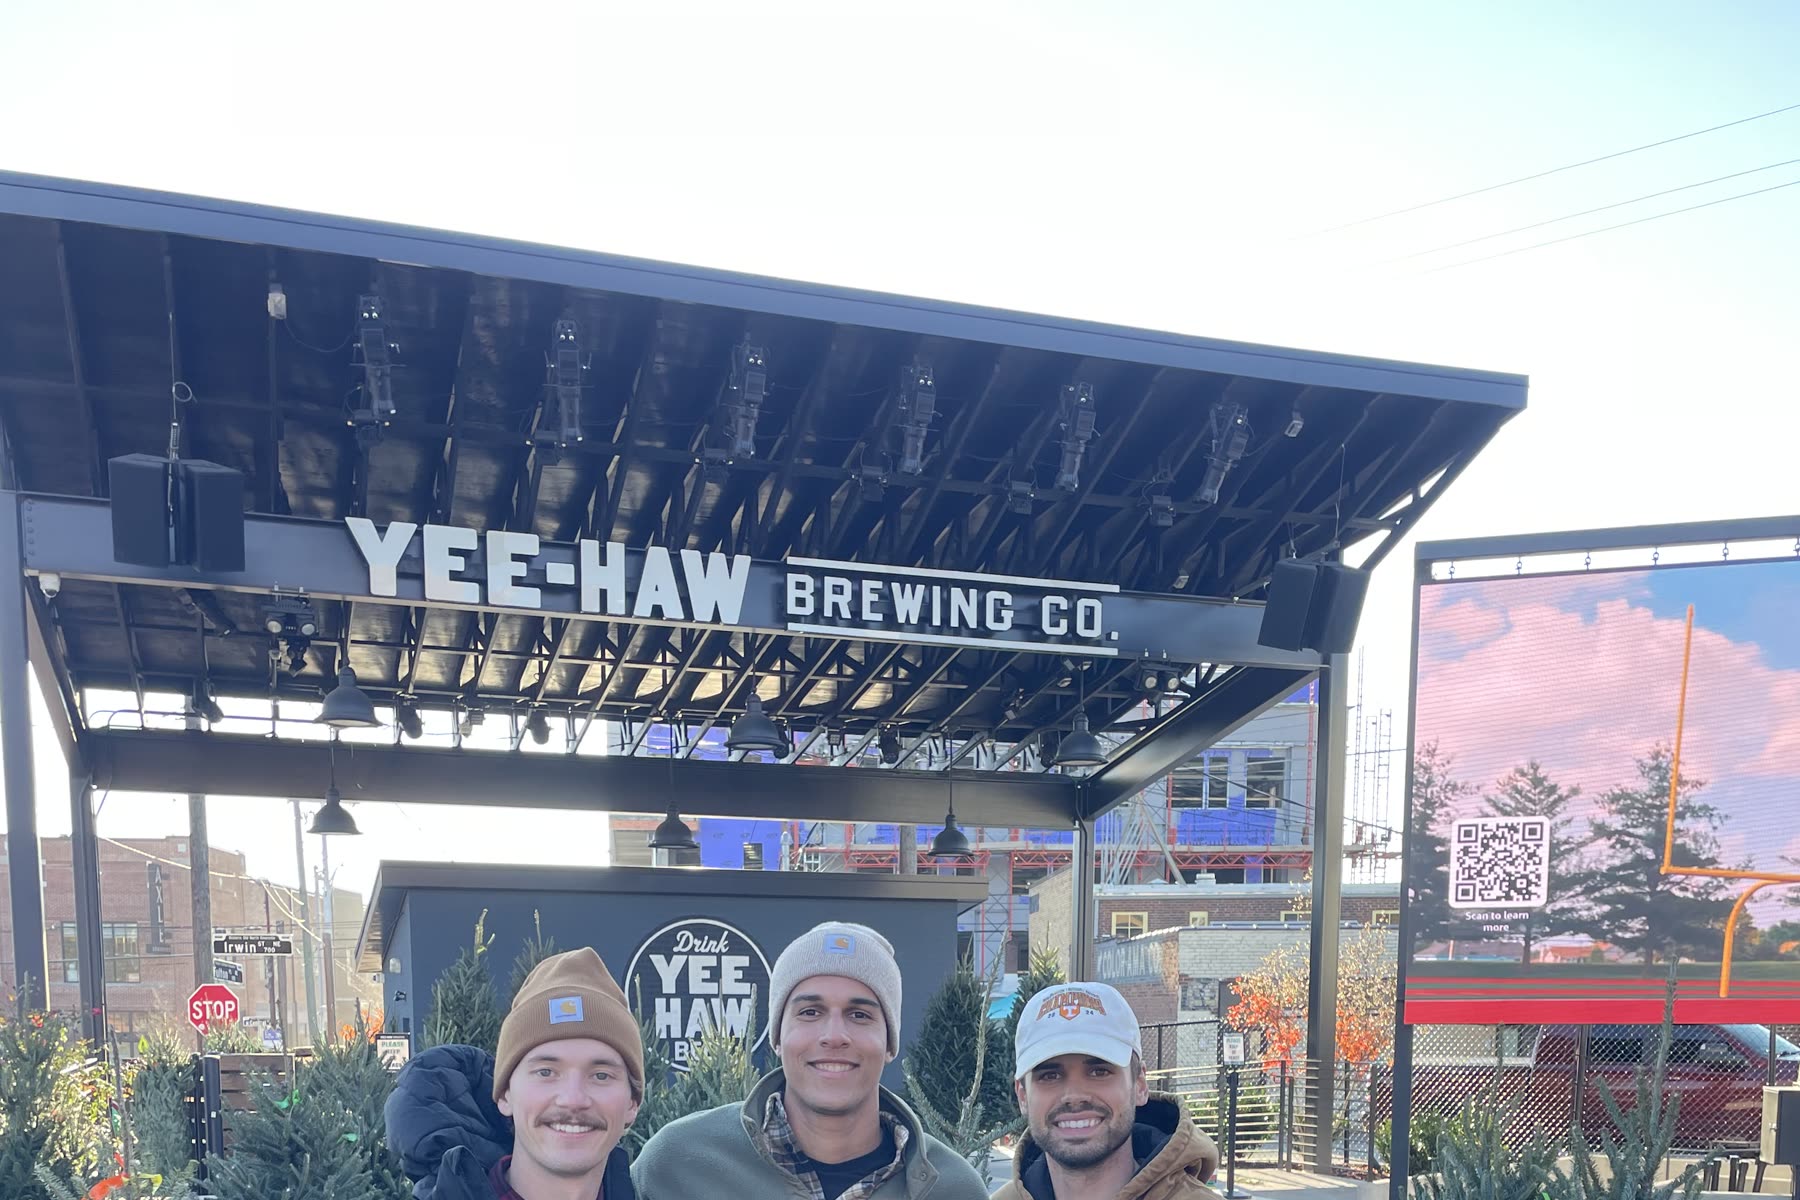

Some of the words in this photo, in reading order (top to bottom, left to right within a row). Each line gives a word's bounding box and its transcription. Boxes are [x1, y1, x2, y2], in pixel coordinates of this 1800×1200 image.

[344, 516, 751, 625] YEE-HAW
[785, 573, 1014, 631] BREWING
[1041, 595, 1119, 641] CO.
[1465, 911, 1489, 921] Scan
[1491, 911, 1502, 920] to
[1503, 911, 1529, 920] learn
[1483, 924, 1509, 932] more
[224, 941, 257, 953] Irwin
[672, 930, 729, 953] Drink
[649, 954, 751, 995] YEE
[192, 1000, 236, 1020] STOP
[655, 998, 752, 1039] HAW
